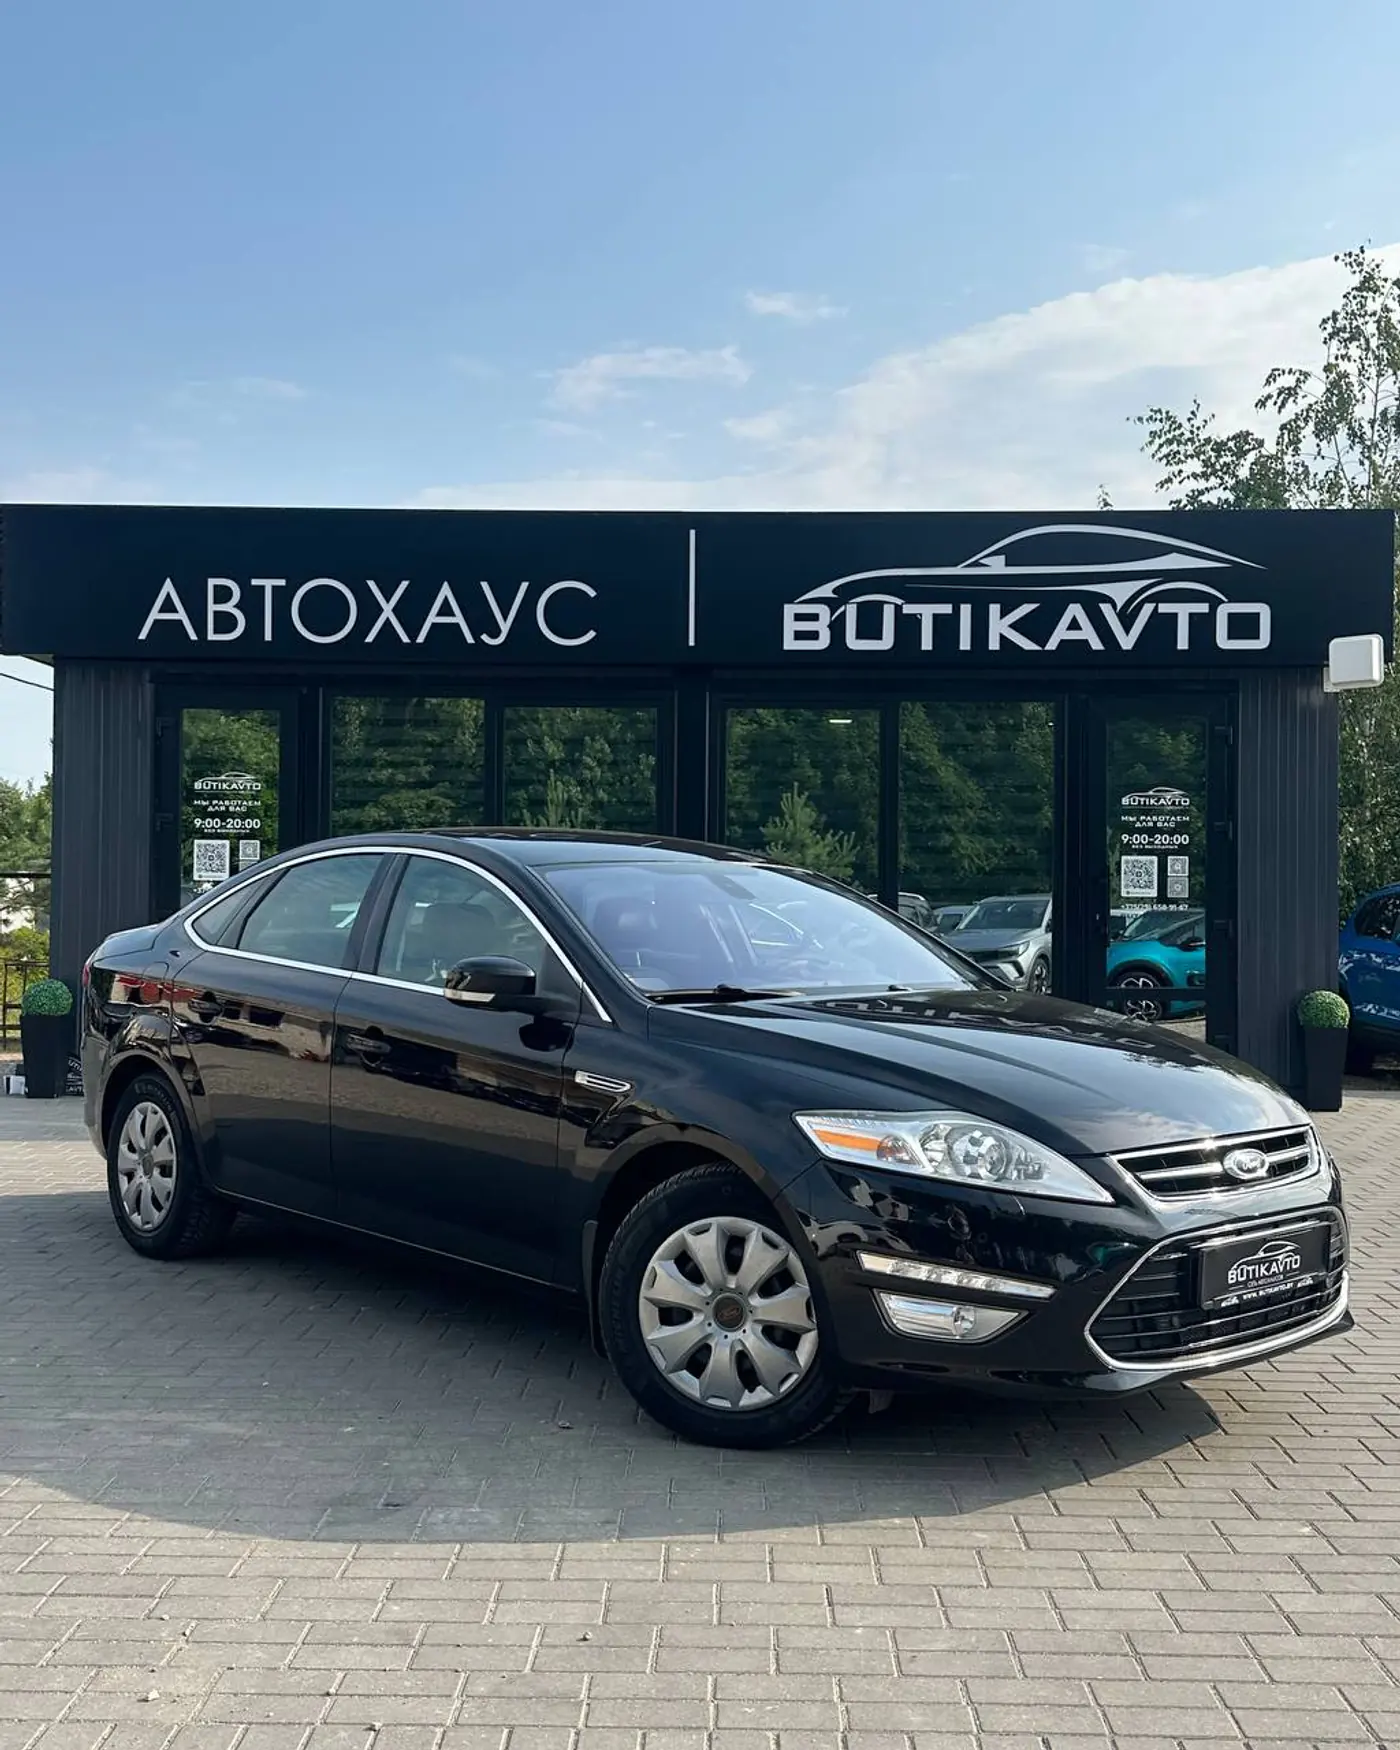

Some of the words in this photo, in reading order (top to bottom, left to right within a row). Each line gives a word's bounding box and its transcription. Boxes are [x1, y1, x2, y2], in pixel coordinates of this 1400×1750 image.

[138, 576, 597, 646] АВТОХАУС
[783, 602, 1271, 651] BUTIKAVTO
[194, 781, 261, 790] BUTIKAVTO
[1121, 797, 1190, 806] BUTIKAVTO
[194, 818, 261, 829] 9:00-20:00
[1121, 833, 1190, 845] 9:00-20:00
[1228, 1255, 1300, 1285] BUTIKAVTO
